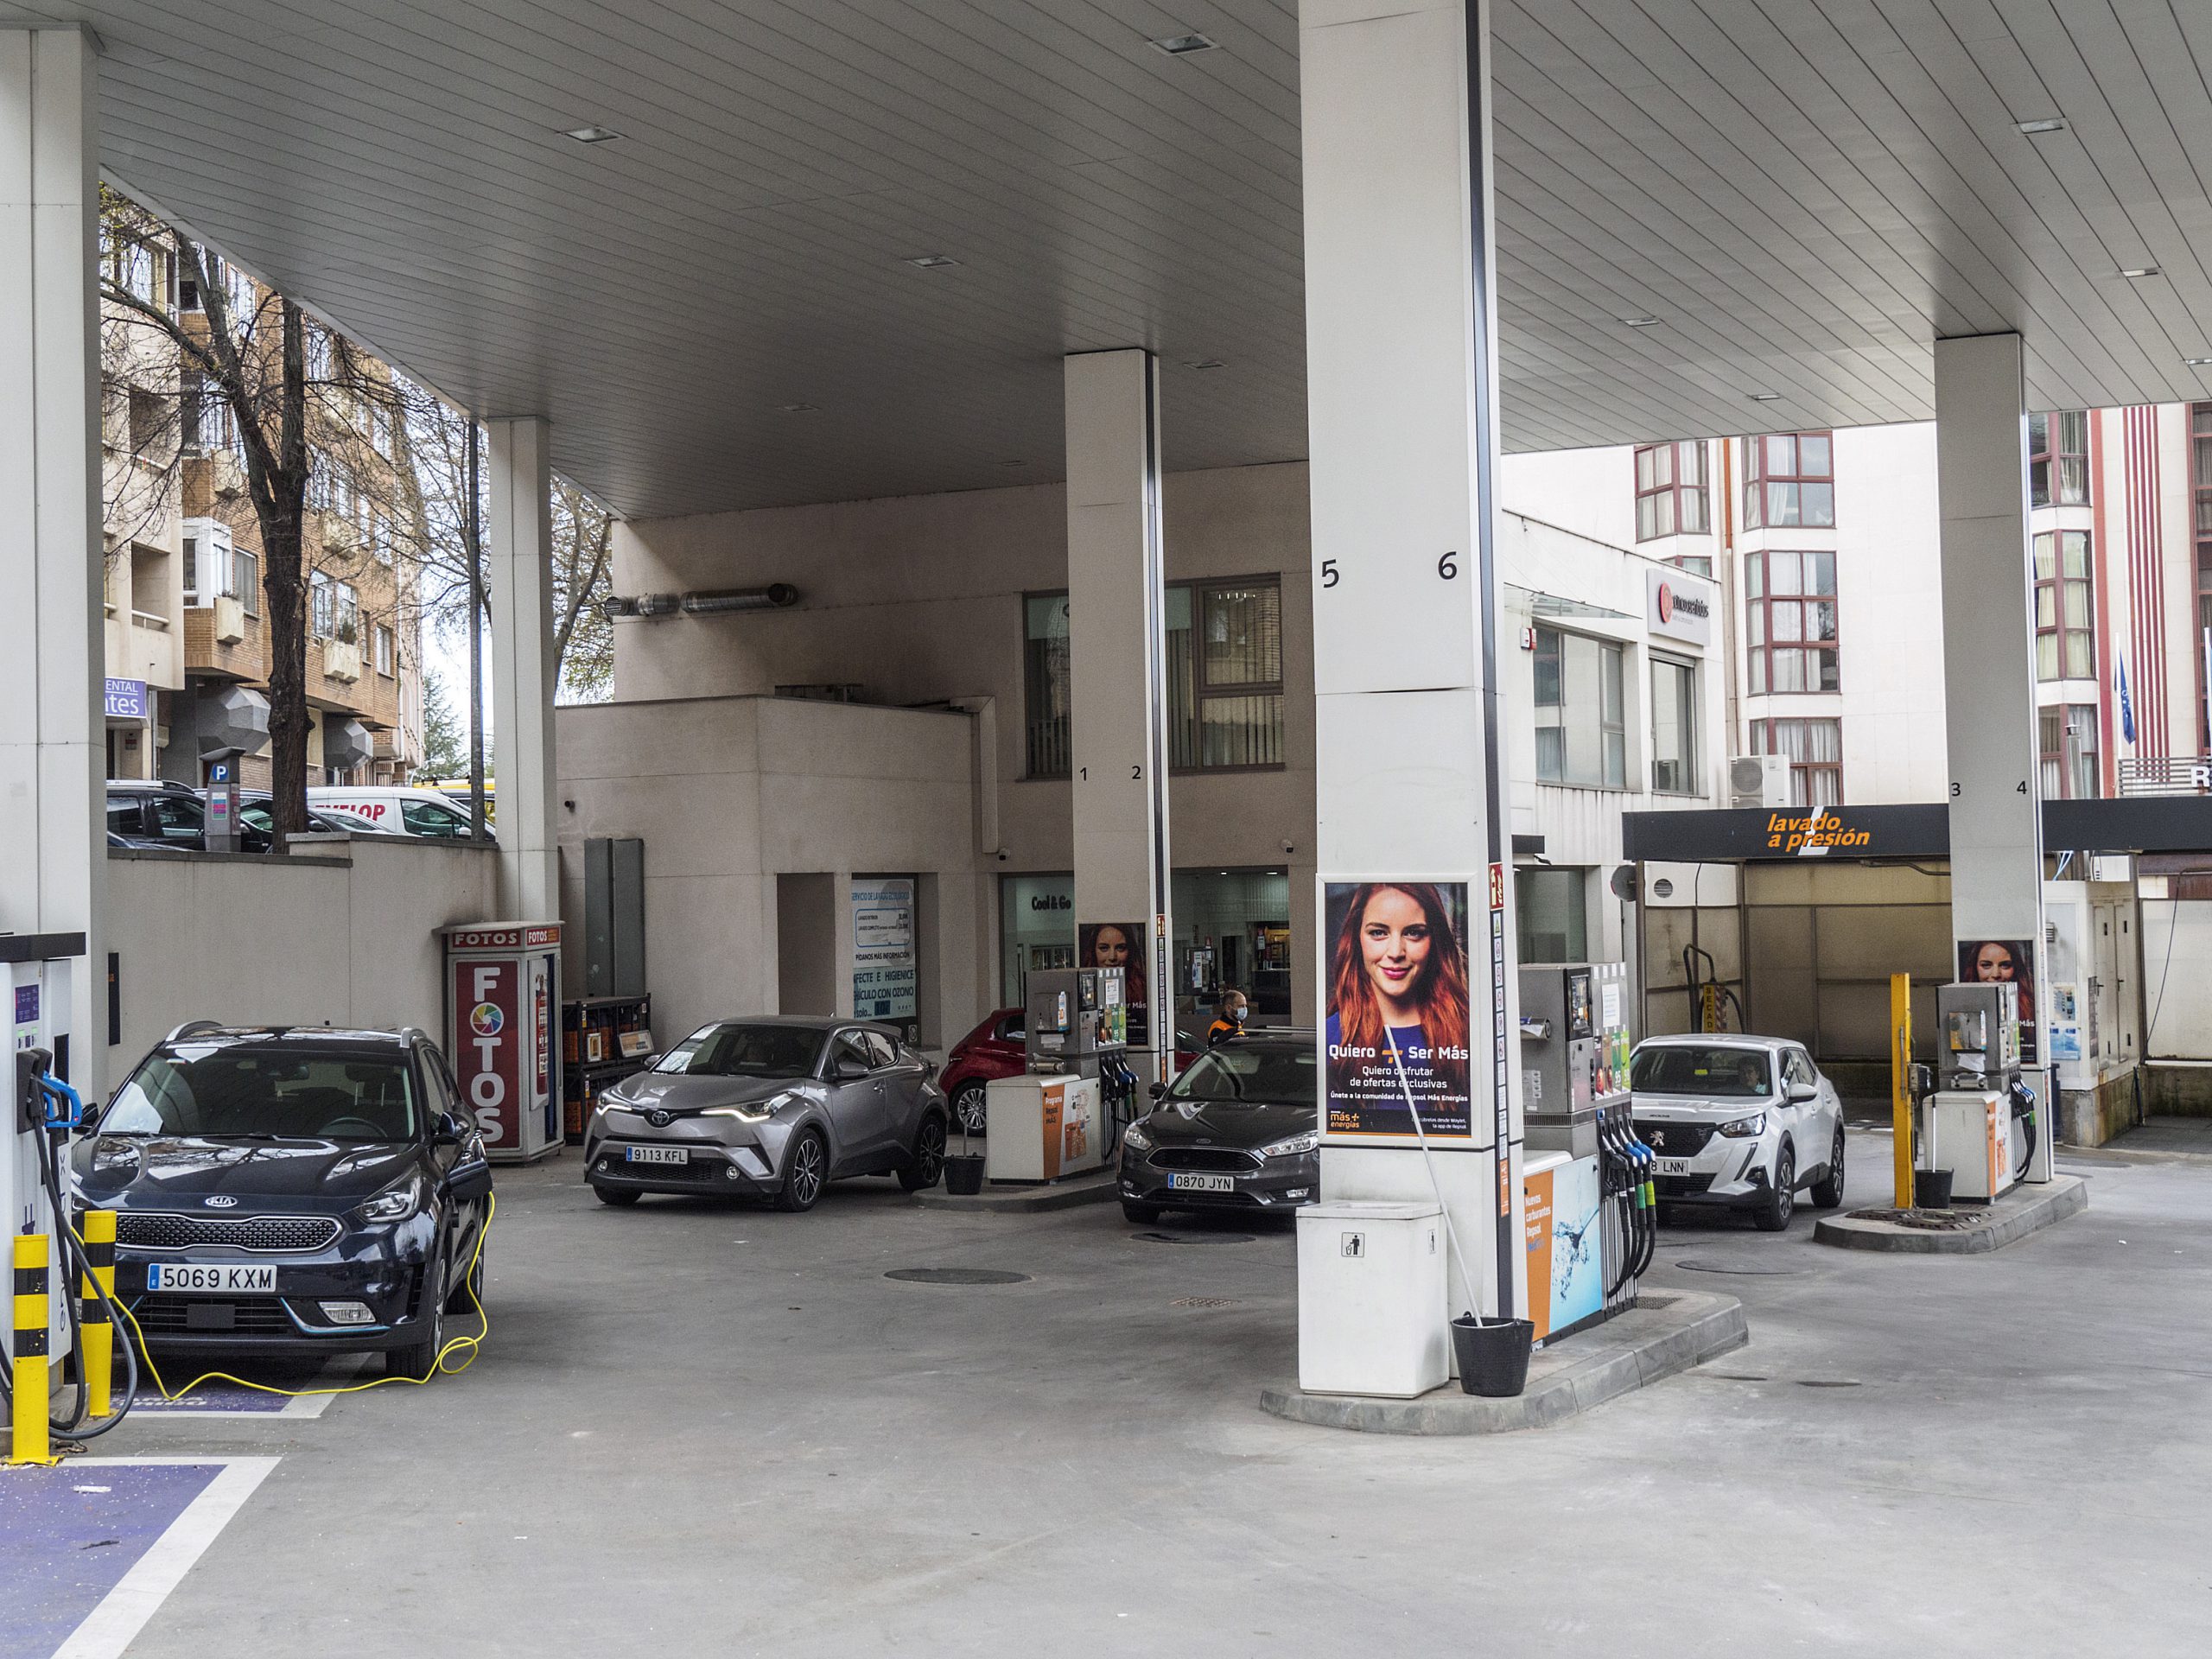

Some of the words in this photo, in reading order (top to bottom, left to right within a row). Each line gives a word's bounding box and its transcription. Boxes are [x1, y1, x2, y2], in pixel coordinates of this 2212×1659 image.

[1438, 551, 1458, 581] 6
[1321, 559, 1339, 588] 5
[216, 765, 226, 780] P
[1079, 766, 1087, 782] 1
[1131, 766, 1141, 779] 2
[1951, 782, 1961, 797] 3
[2017, 780, 2027, 795] 4
[1767, 812, 1841, 832] lavado
[1768, 834, 1782, 848] a
[1785, 828, 1871, 852] presión
[1059, 895, 1071, 910] Go
[454, 932, 518, 945] FOTOS
[528, 930, 548, 944] FOTOS
[877, 972, 881, 982] E
[885, 969, 914, 982] HIGIENICE
[878, 988, 891, 999] CON
[893, 987, 914, 997] OZONO
[2019, 1019, 2035, 1028] Más
[1329, 1043, 1376, 1059] Quiero
[1408, 1046, 1433, 1059] Ser
[1439, 1045, 1468, 1059] Más
[1363, 1065, 1392, 1077] Quiero
[1350, 1077, 1361, 1087] de
[1363, 1077, 1396, 1088] ofertas
[1398, 1078, 1447, 1089] eclusivas
[1331, 1090, 1348, 1099] Únete
[1441, 1094, 1468, 1103] Energías
[1331, 1121, 1359, 1129] energías
[634, 1150, 662, 1161] 9113
[664, 1151, 685, 1163] KFL
[1651, 1161, 1657, 1171] 8
[1663, 1161, 1684, 1173] LNN
[1176, 1176, 1205, 1188] 0870
[1209, 1178, 1230, 1189] JYN
[163, 1268, 219, 1287] 5069
[229, 1269, 272, 1288] KXM
